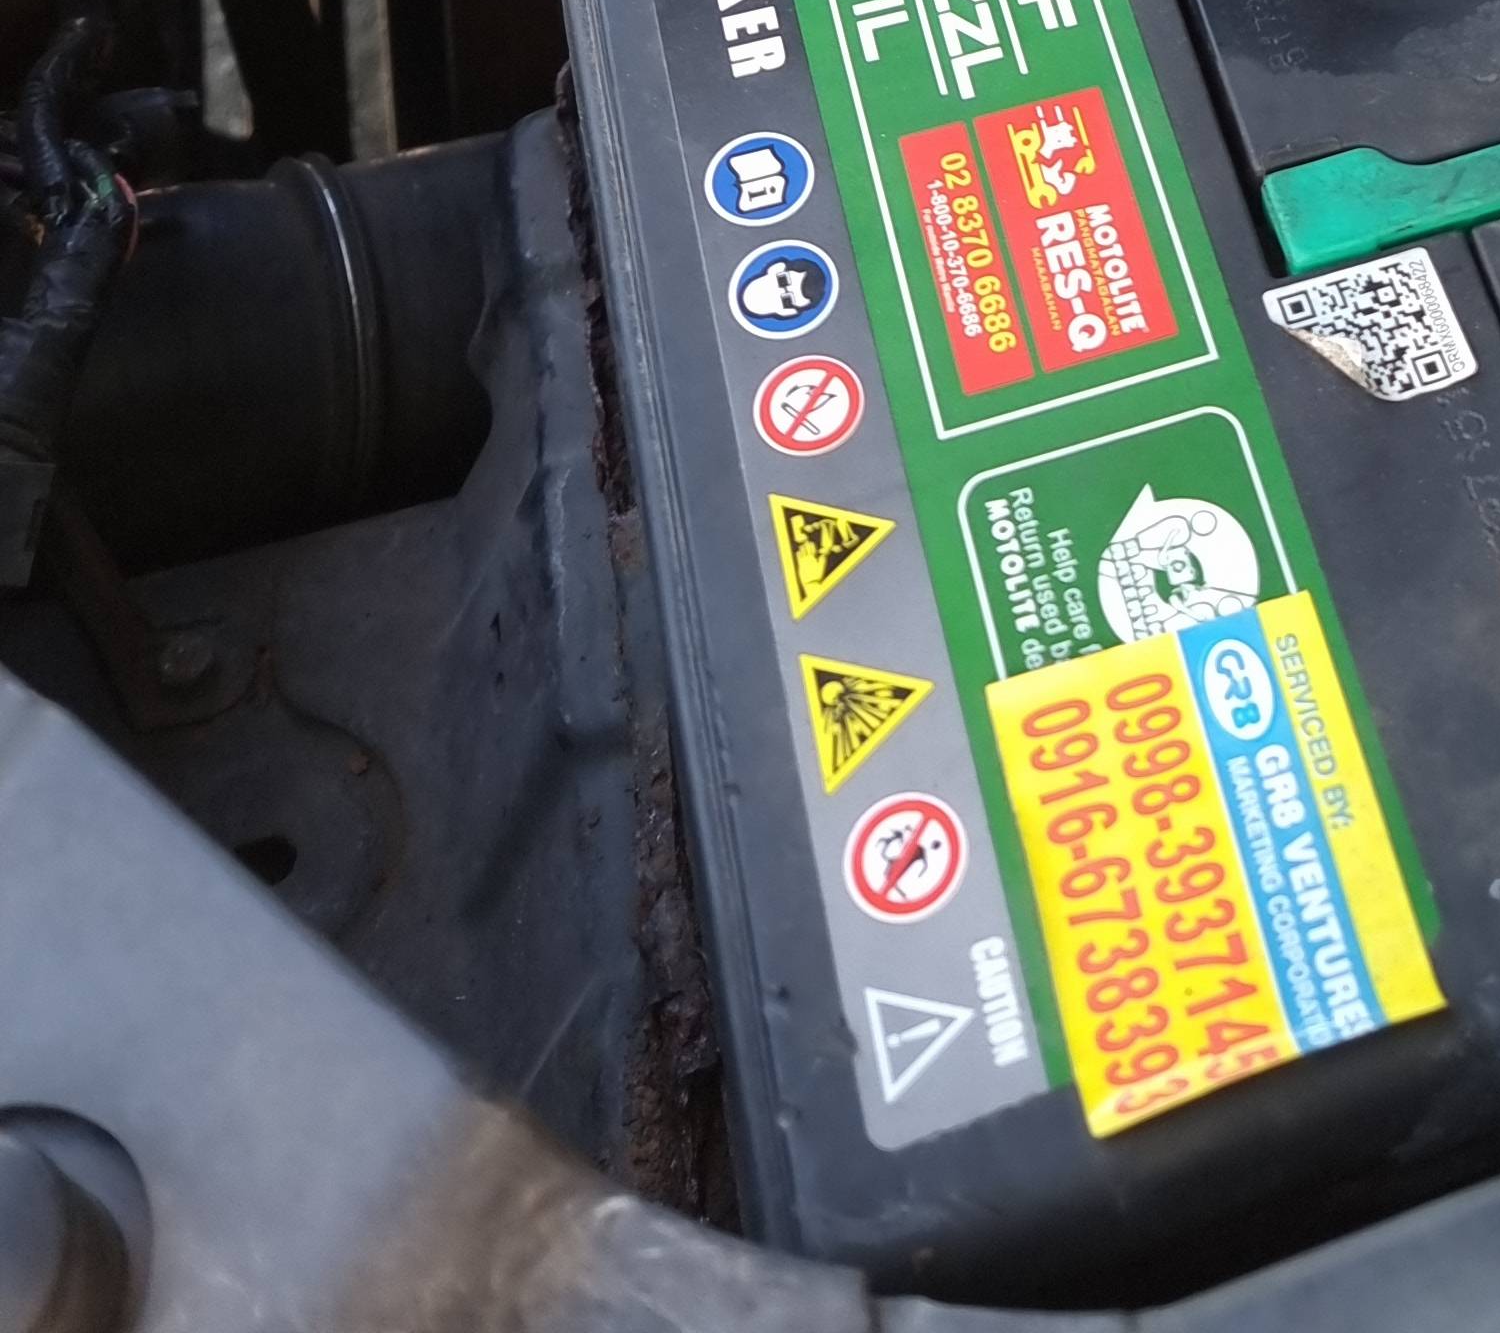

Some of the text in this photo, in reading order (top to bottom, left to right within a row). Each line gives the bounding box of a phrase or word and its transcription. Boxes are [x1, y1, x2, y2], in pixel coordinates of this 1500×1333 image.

[926, 179, 983, 338] 1-800-10-370-6686
[939, 151, 1018, 353] 02 8370 6686
[1034, 212, 1108, 353] RES-Q
[1074, 208, 1124, 337] PANGMATAGALAN
[1083, 204, 1147, 333] MOTOLITE
[984, 498, 1041, 633] MOTOLITE
[1008, 486, 1046, 568] Return
[1032, 574, 1069, 635] used
[1047, 527, 1079, 583] Help
[1063, 587, 1093, 640] care
[1255, 743, 1307, 829] GR8
[1276, 633, 1356, 830] SERVICED BY:
[1105, 672, 1282, 1083] 0998-3937145
[1226, 754, 1284, 895] MARKETING
[1022, 699, 1192, 1117] 0916-6738393
[968, 935, 1032, 1069] CAUTION
